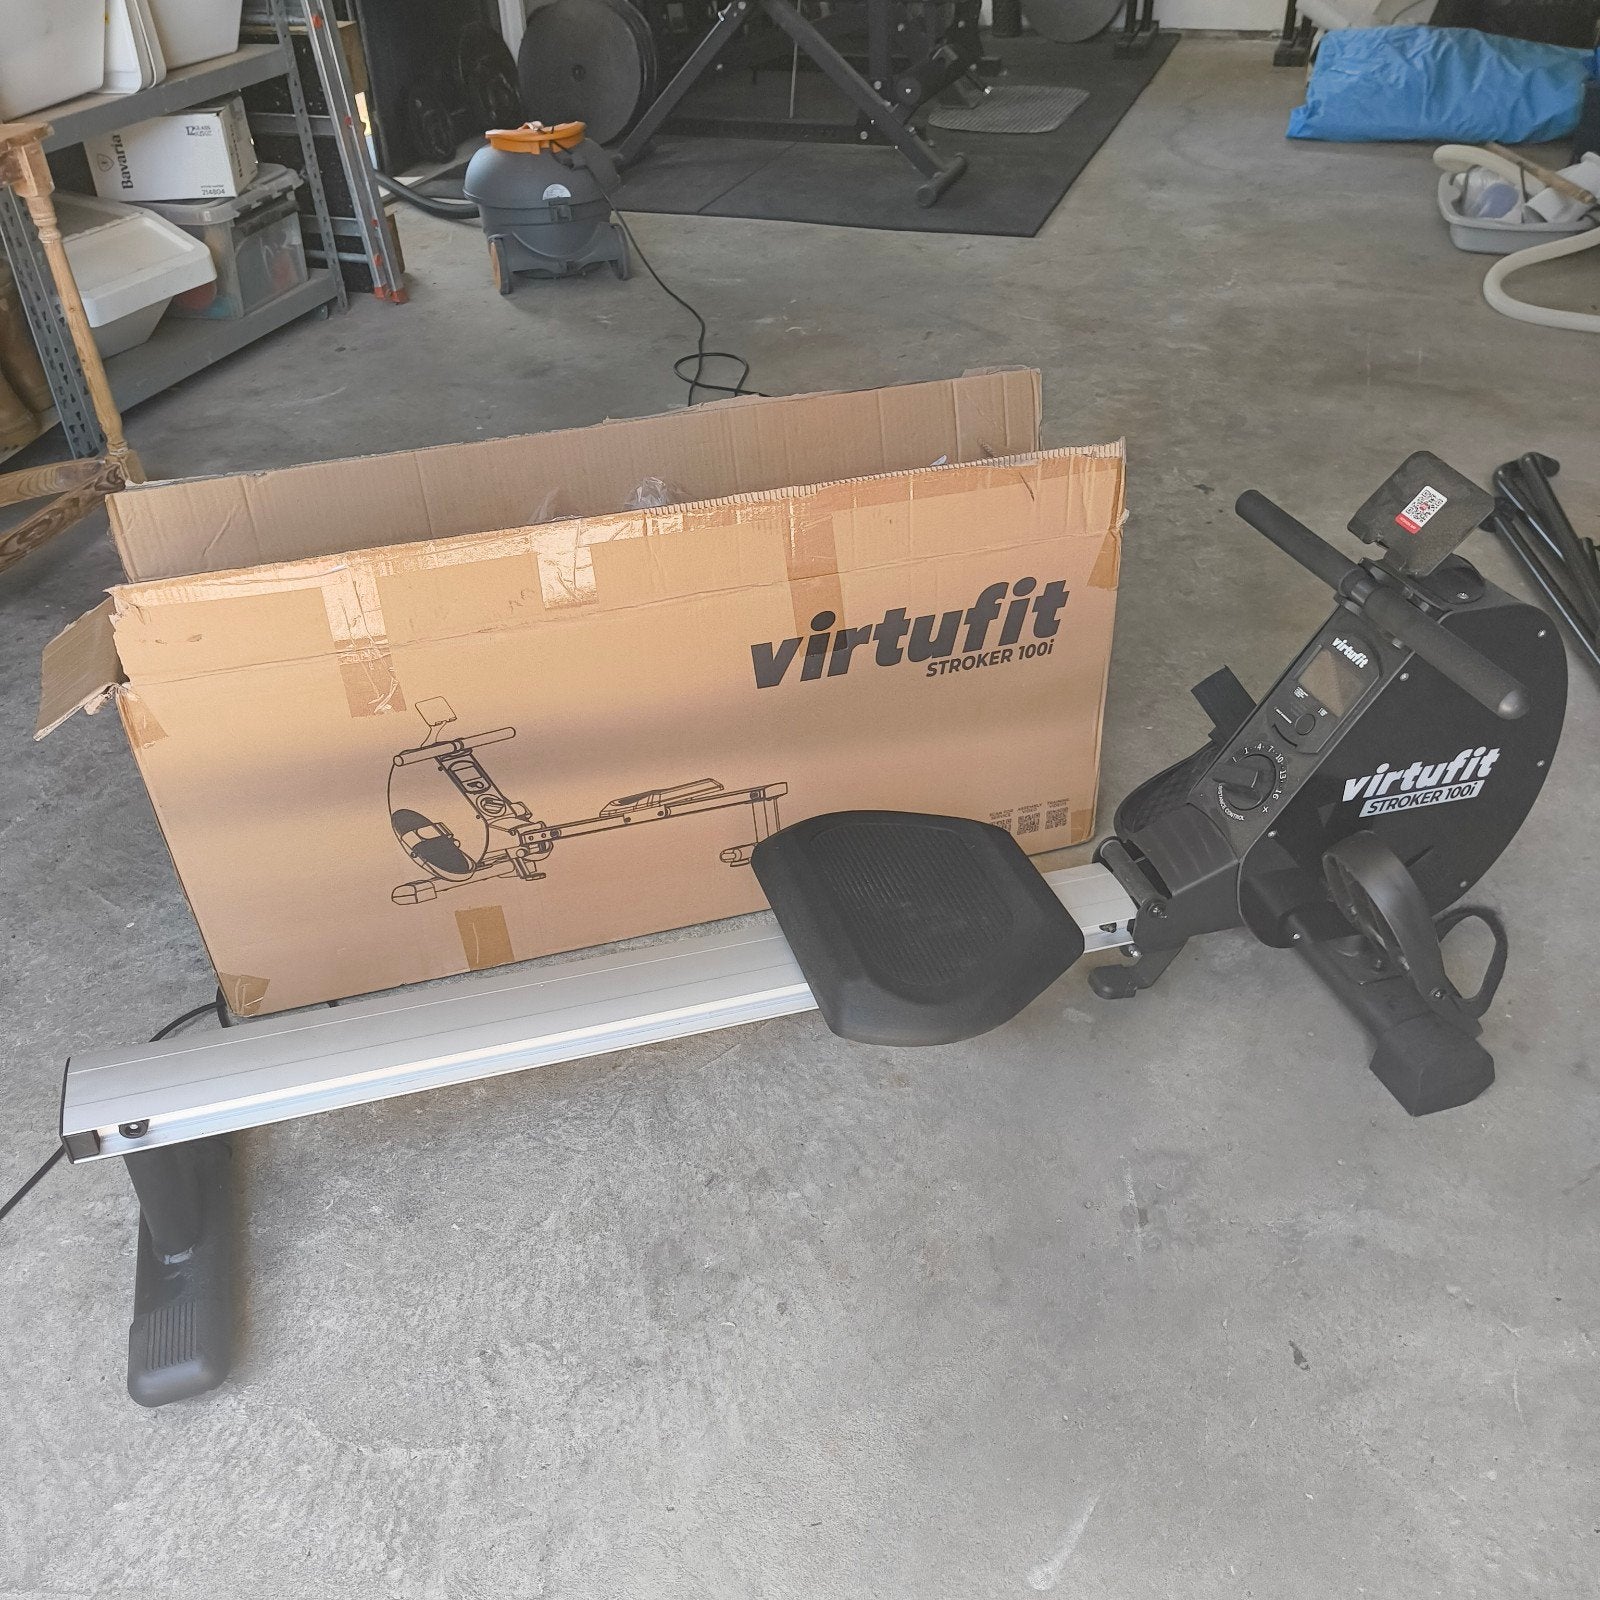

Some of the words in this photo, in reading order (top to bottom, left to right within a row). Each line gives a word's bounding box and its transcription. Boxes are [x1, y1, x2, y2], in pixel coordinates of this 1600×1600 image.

[112, 134, 134, 190] Bavaria
[750, 576, 1070, 690] virtufit
[926, 649, 1012, 678] STROKER
[1019, 639, 1055, 660] 100i
[1332, 637, 1369, 669] virtufit
[1275, 753, 1284, 763] 10
[1342, 746, 1500, 802] virtufit
[1367, 789, 1444, 814] STROKER
[1445, 782, 1479, 801] 100i
